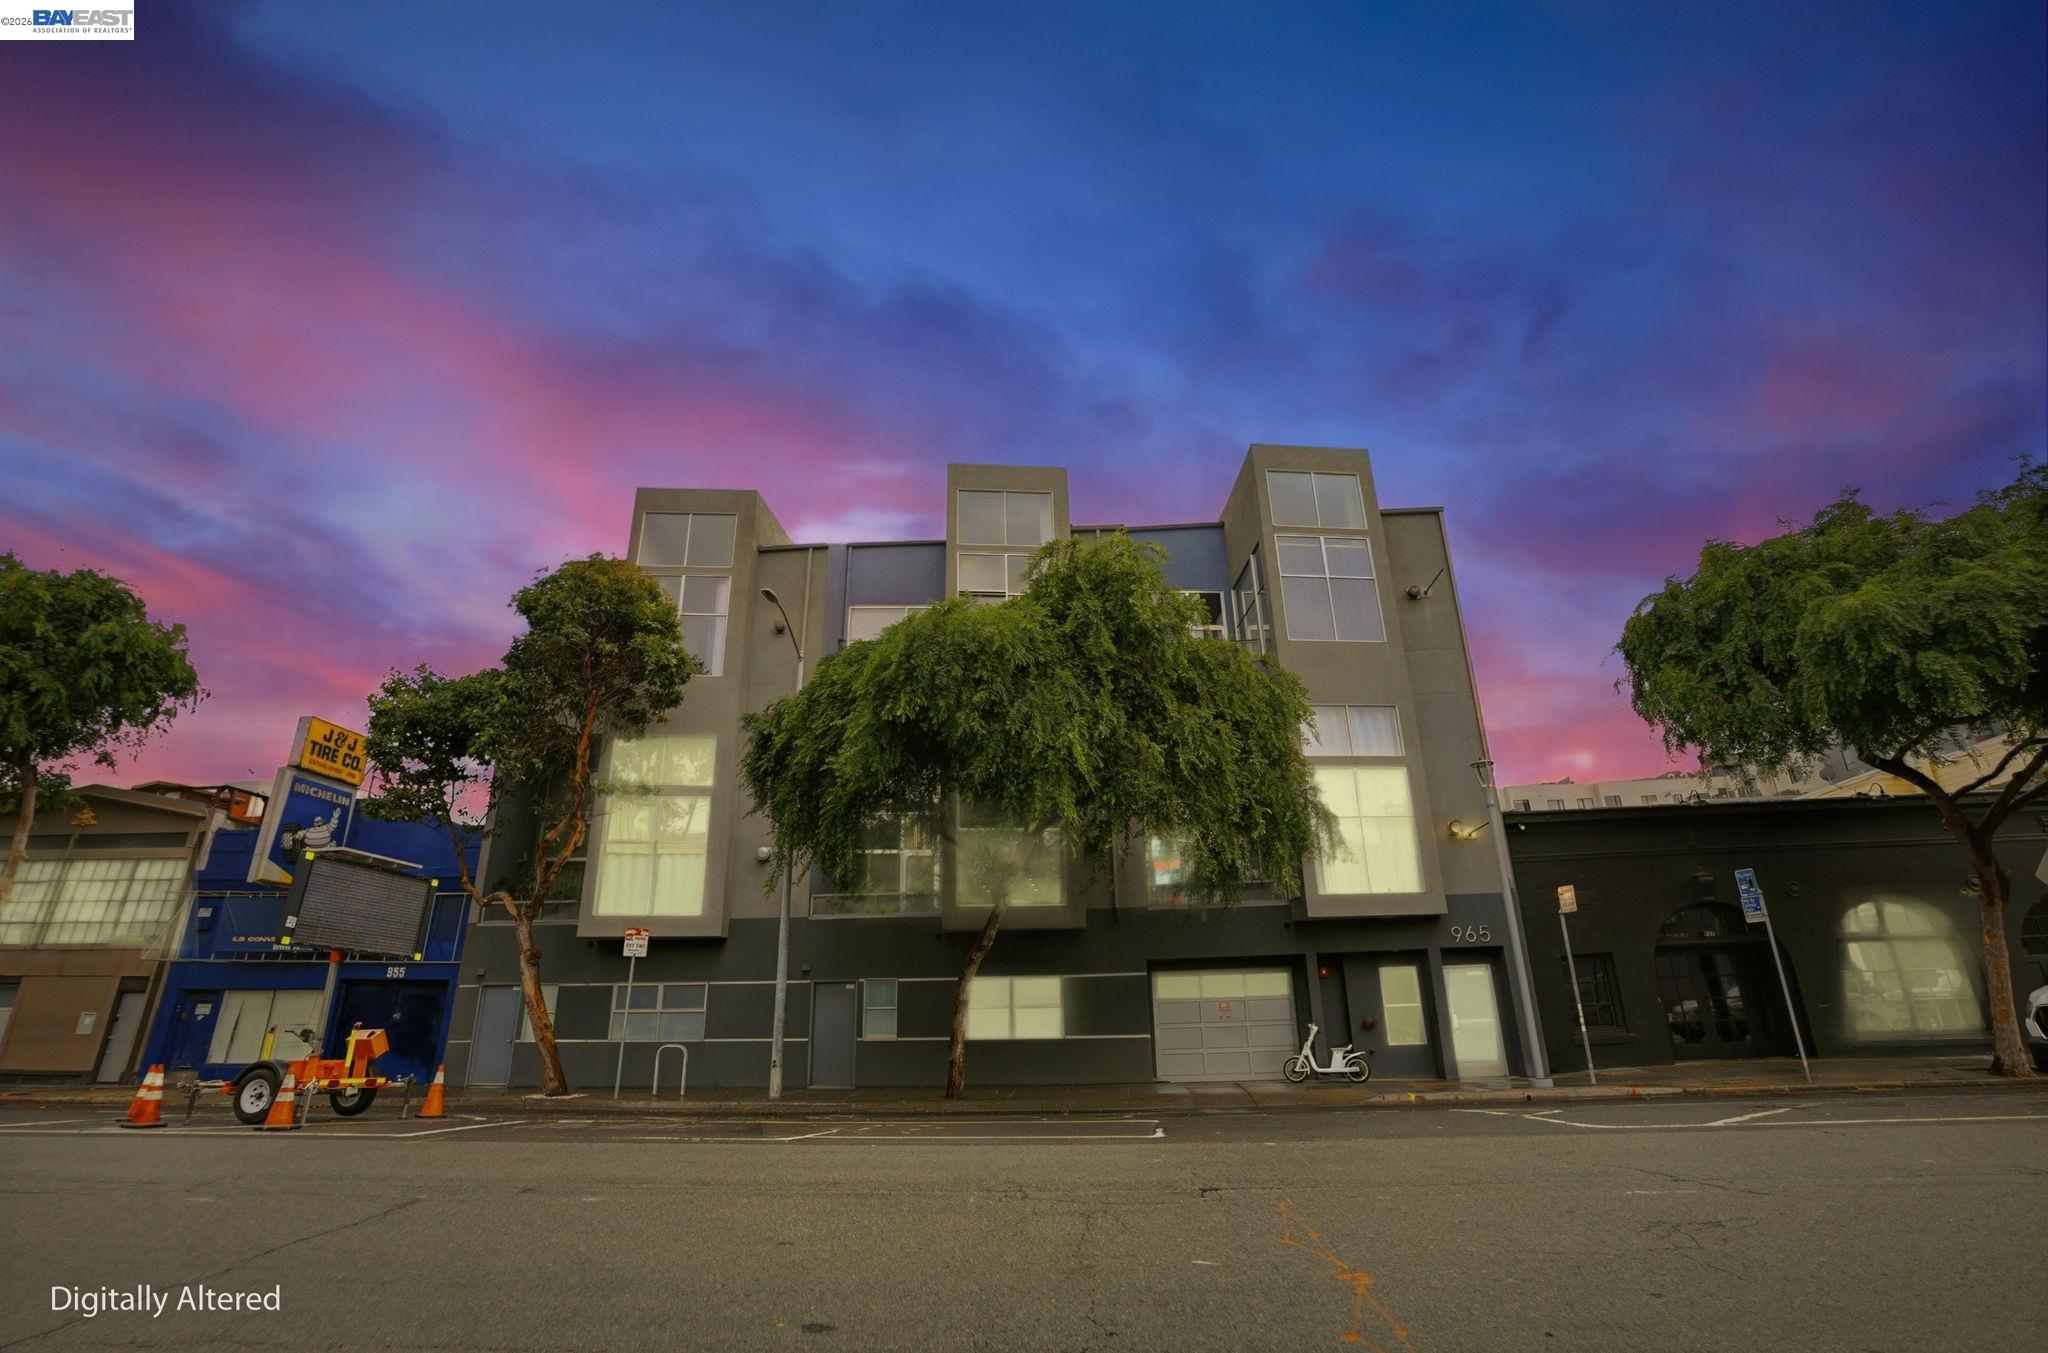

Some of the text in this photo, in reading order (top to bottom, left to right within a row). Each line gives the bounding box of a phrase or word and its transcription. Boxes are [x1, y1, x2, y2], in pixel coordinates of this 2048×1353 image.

[334, 731, 349, 749] &
[310, 740, 340, 763] TIRE
[342, 752, 362, 772] CO.
[294, 782, 351, 806] MICHELIN
[1451, 924, 1491, 943] 965
